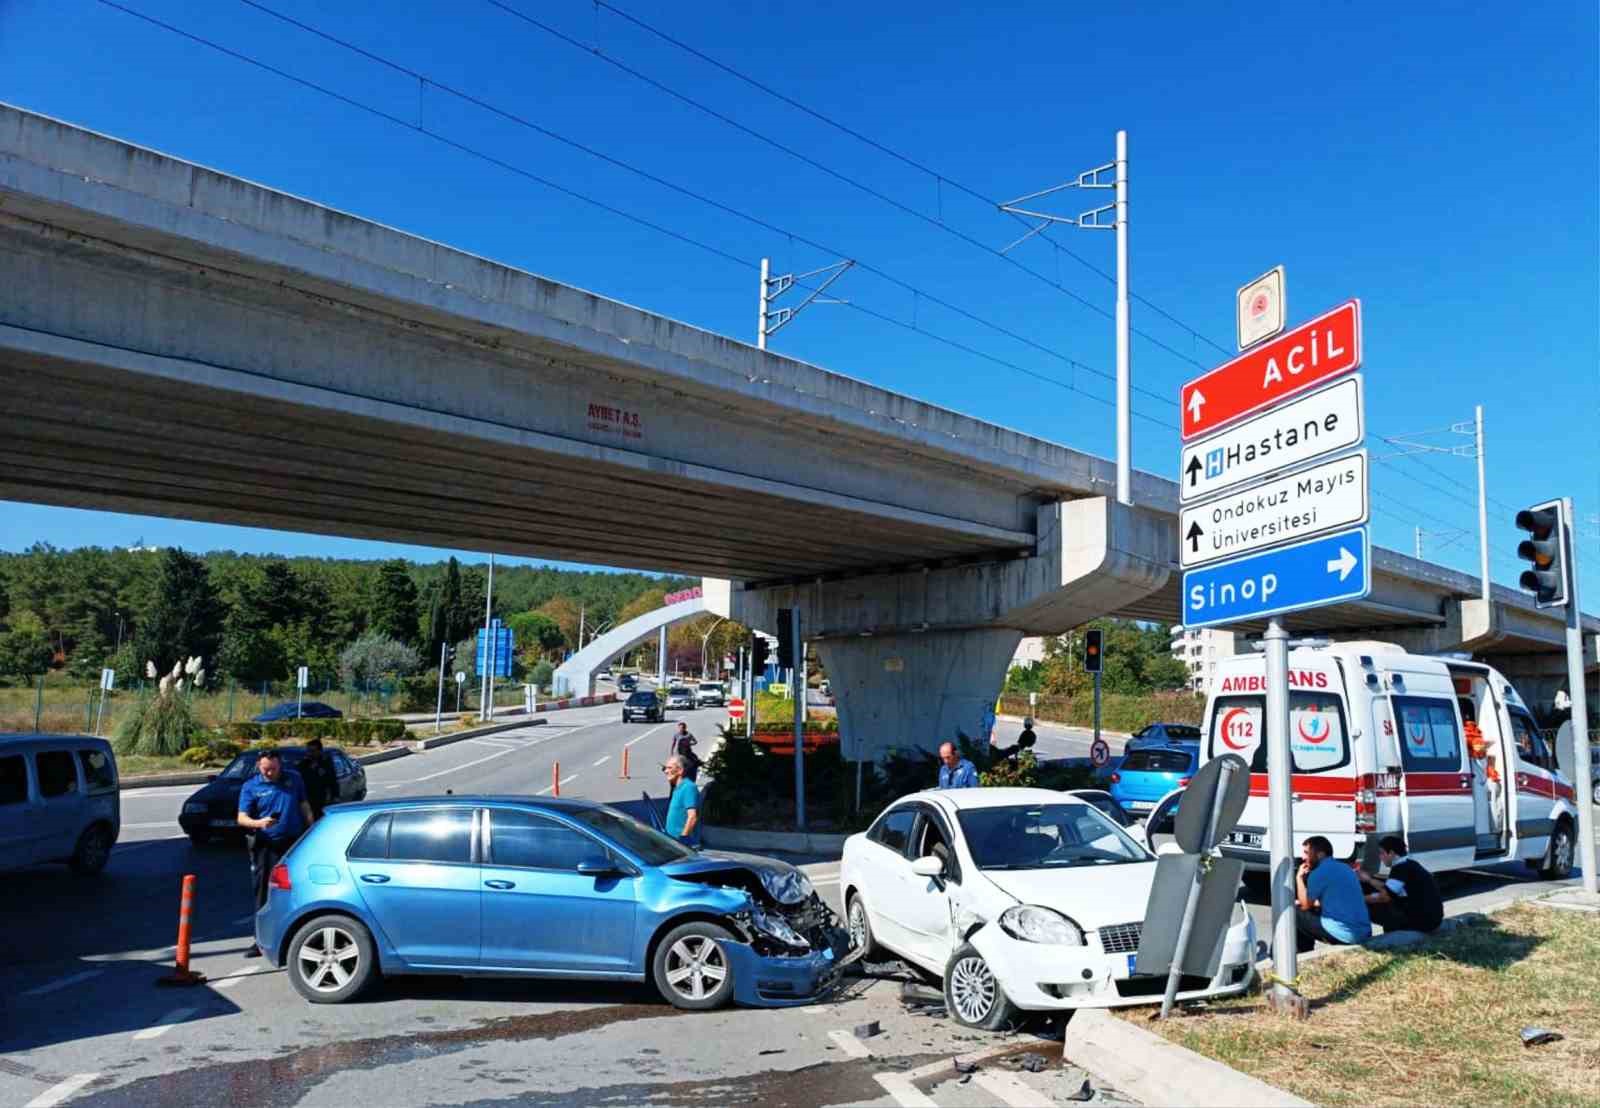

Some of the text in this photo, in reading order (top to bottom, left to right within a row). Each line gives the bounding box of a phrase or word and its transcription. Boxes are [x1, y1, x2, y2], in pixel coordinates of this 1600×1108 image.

[1262, 329, 1345, 389] ACİL
[1227, 413, 1339, 469] Hastane
[1212, 469, 1356, 524] Ondokuz Mayıs
[1212, 506, 1318, 550] Üniversitesi
[1190, 573, 1278, 610] Sinop
[1222, 670, 1328, 692] AMBANS
[1229, 721, 1253, 737] 112
